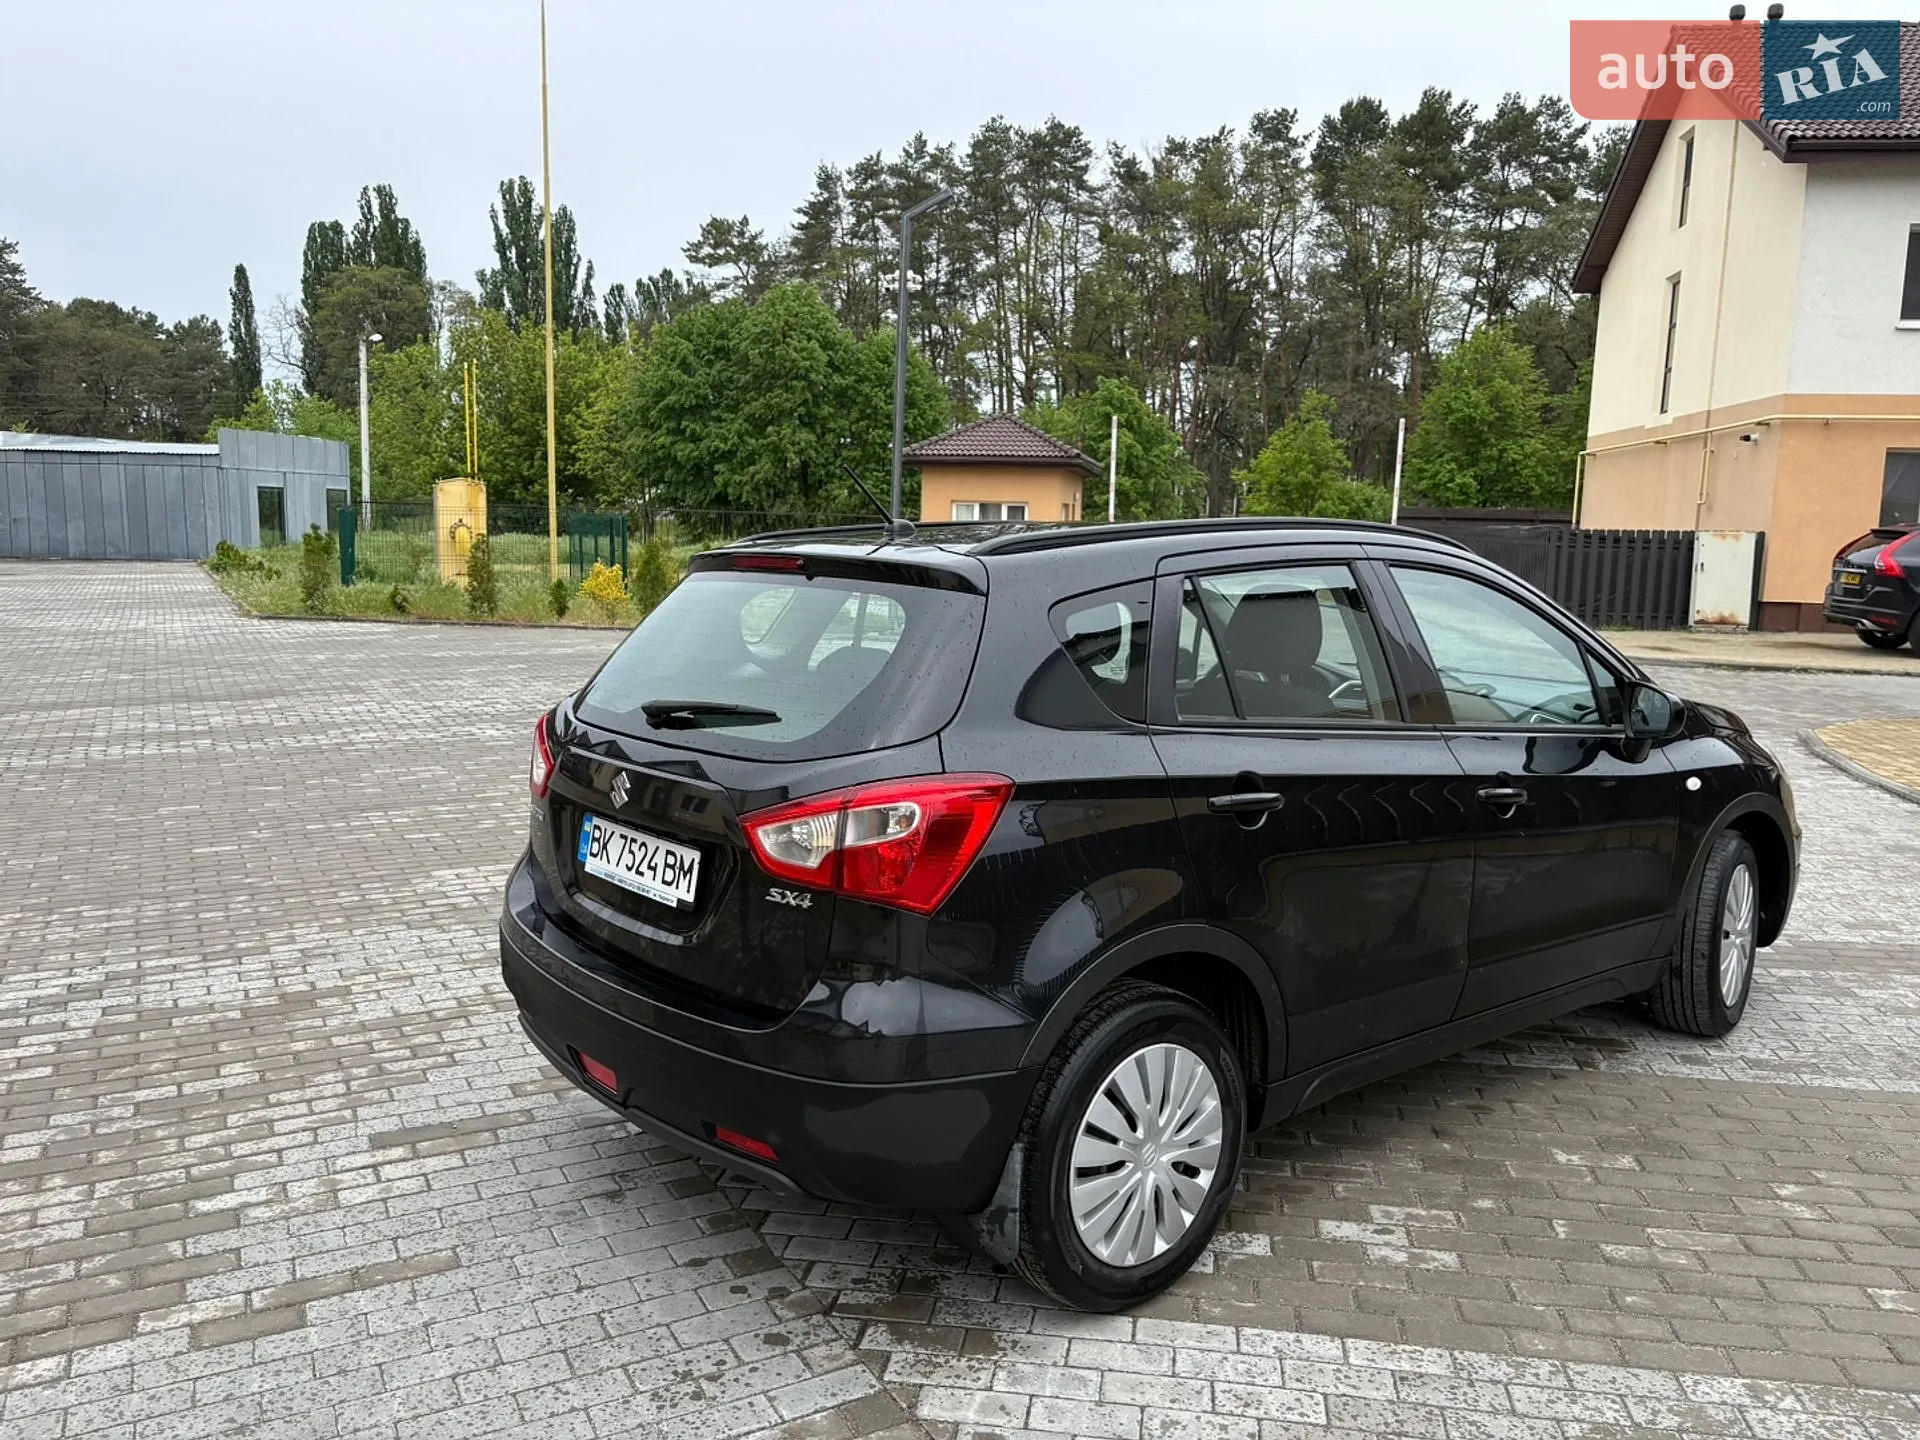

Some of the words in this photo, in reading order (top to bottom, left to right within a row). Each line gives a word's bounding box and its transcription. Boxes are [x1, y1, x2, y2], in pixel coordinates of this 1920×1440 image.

[589, 824, 615, 865] BK
[616, 833, 660, 882] 7524
[661, 849, 696, 894] BM
[765, 887, 813, 909] SX4
